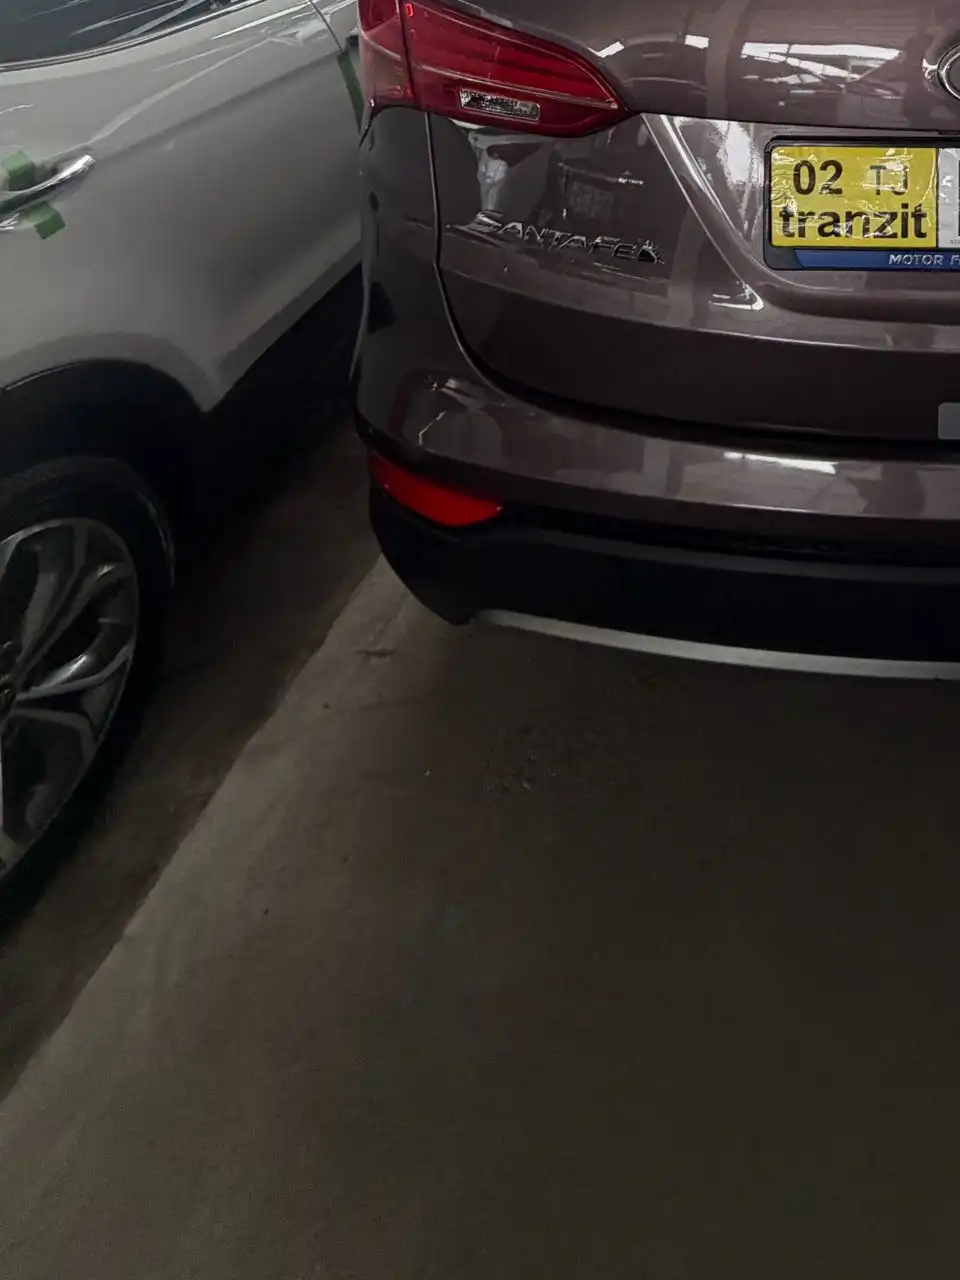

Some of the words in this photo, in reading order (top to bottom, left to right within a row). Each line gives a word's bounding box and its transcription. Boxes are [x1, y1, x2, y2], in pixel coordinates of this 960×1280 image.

[793, 159, 843, 195] 02
[869, 165, 908, 195] TJ
[779, 203, 928, 239] tranzit
[888, 253, 944, 266] MOTOR
